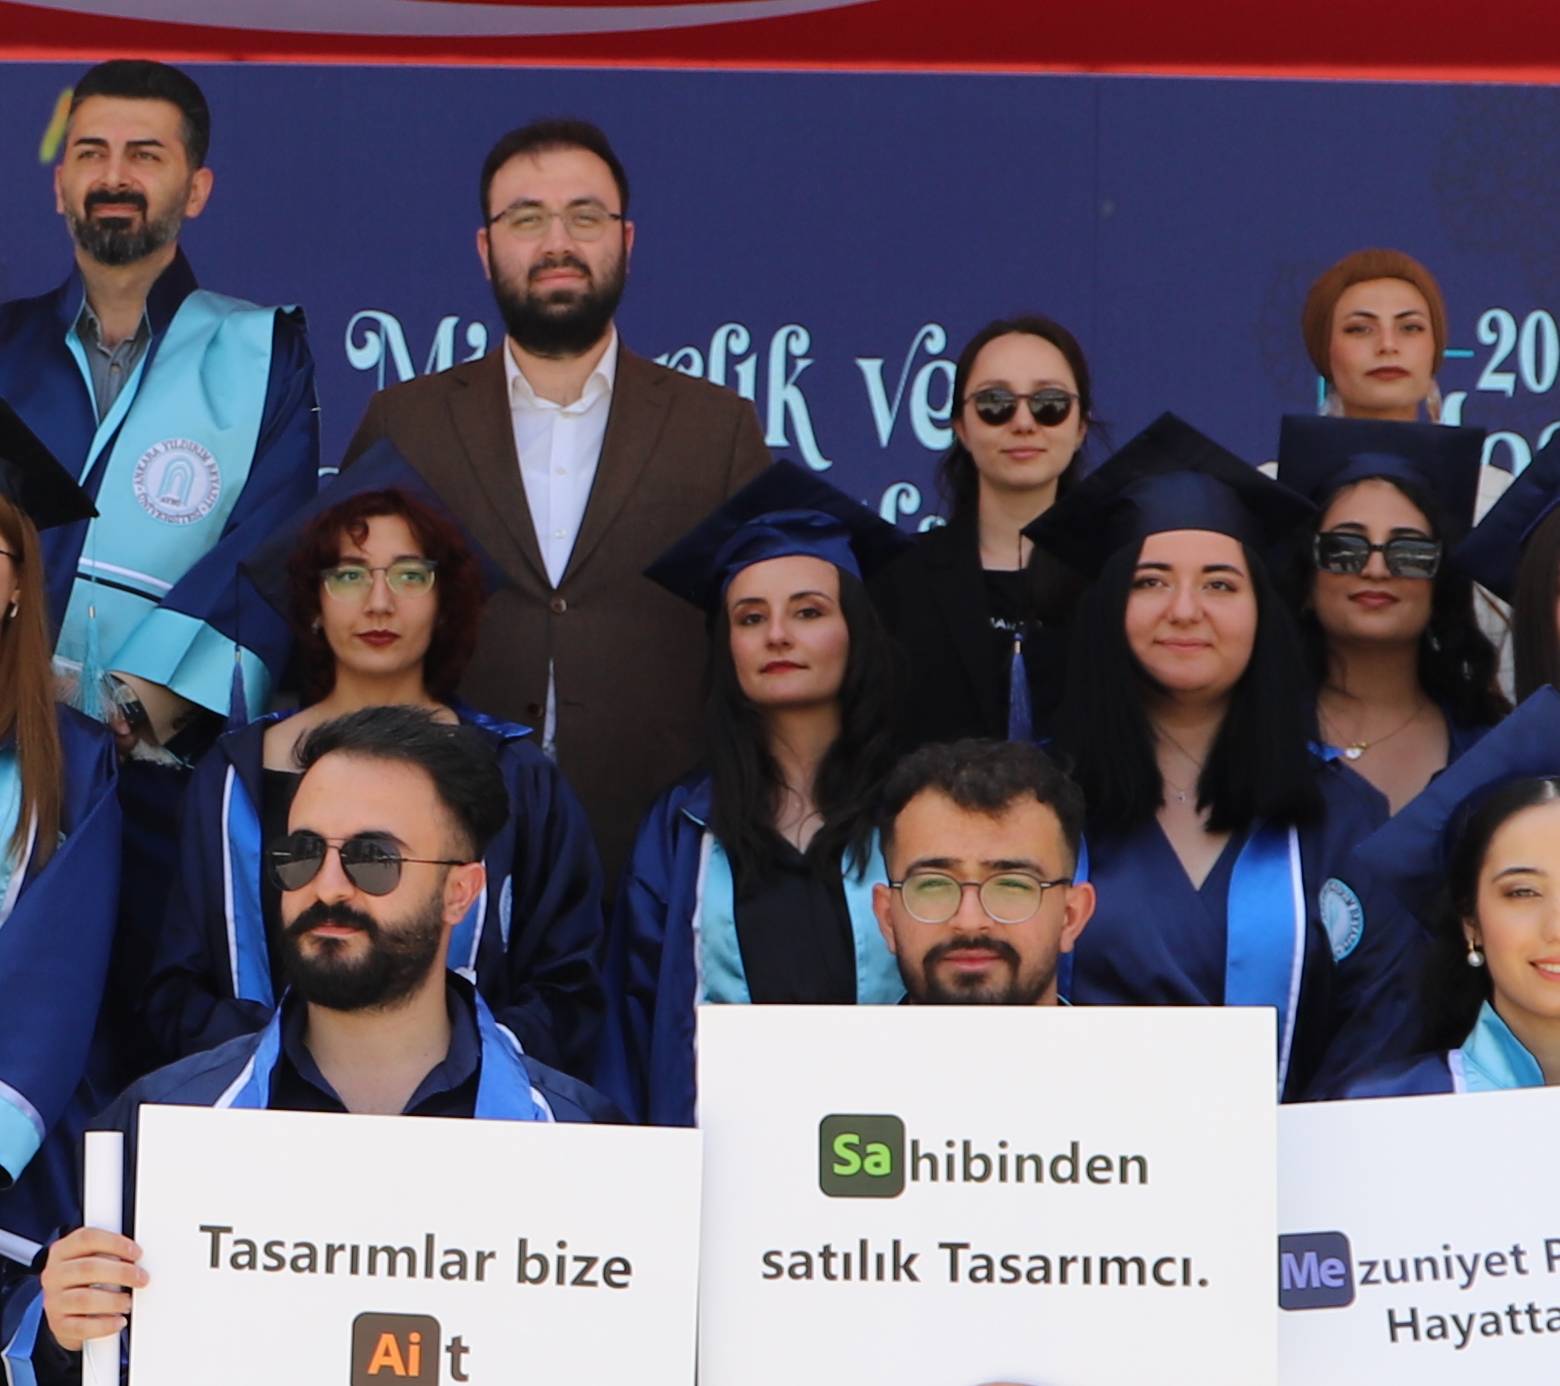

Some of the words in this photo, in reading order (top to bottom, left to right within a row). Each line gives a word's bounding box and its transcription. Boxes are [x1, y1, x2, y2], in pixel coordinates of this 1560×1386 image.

[198, 1224, 496, 1282] Tasarımlar
[516, 1238, 633, 1289] bize
[761, 1239, 920, 1283] satılık
[938, 1241, 1210, 1288] Tasarımcı.
